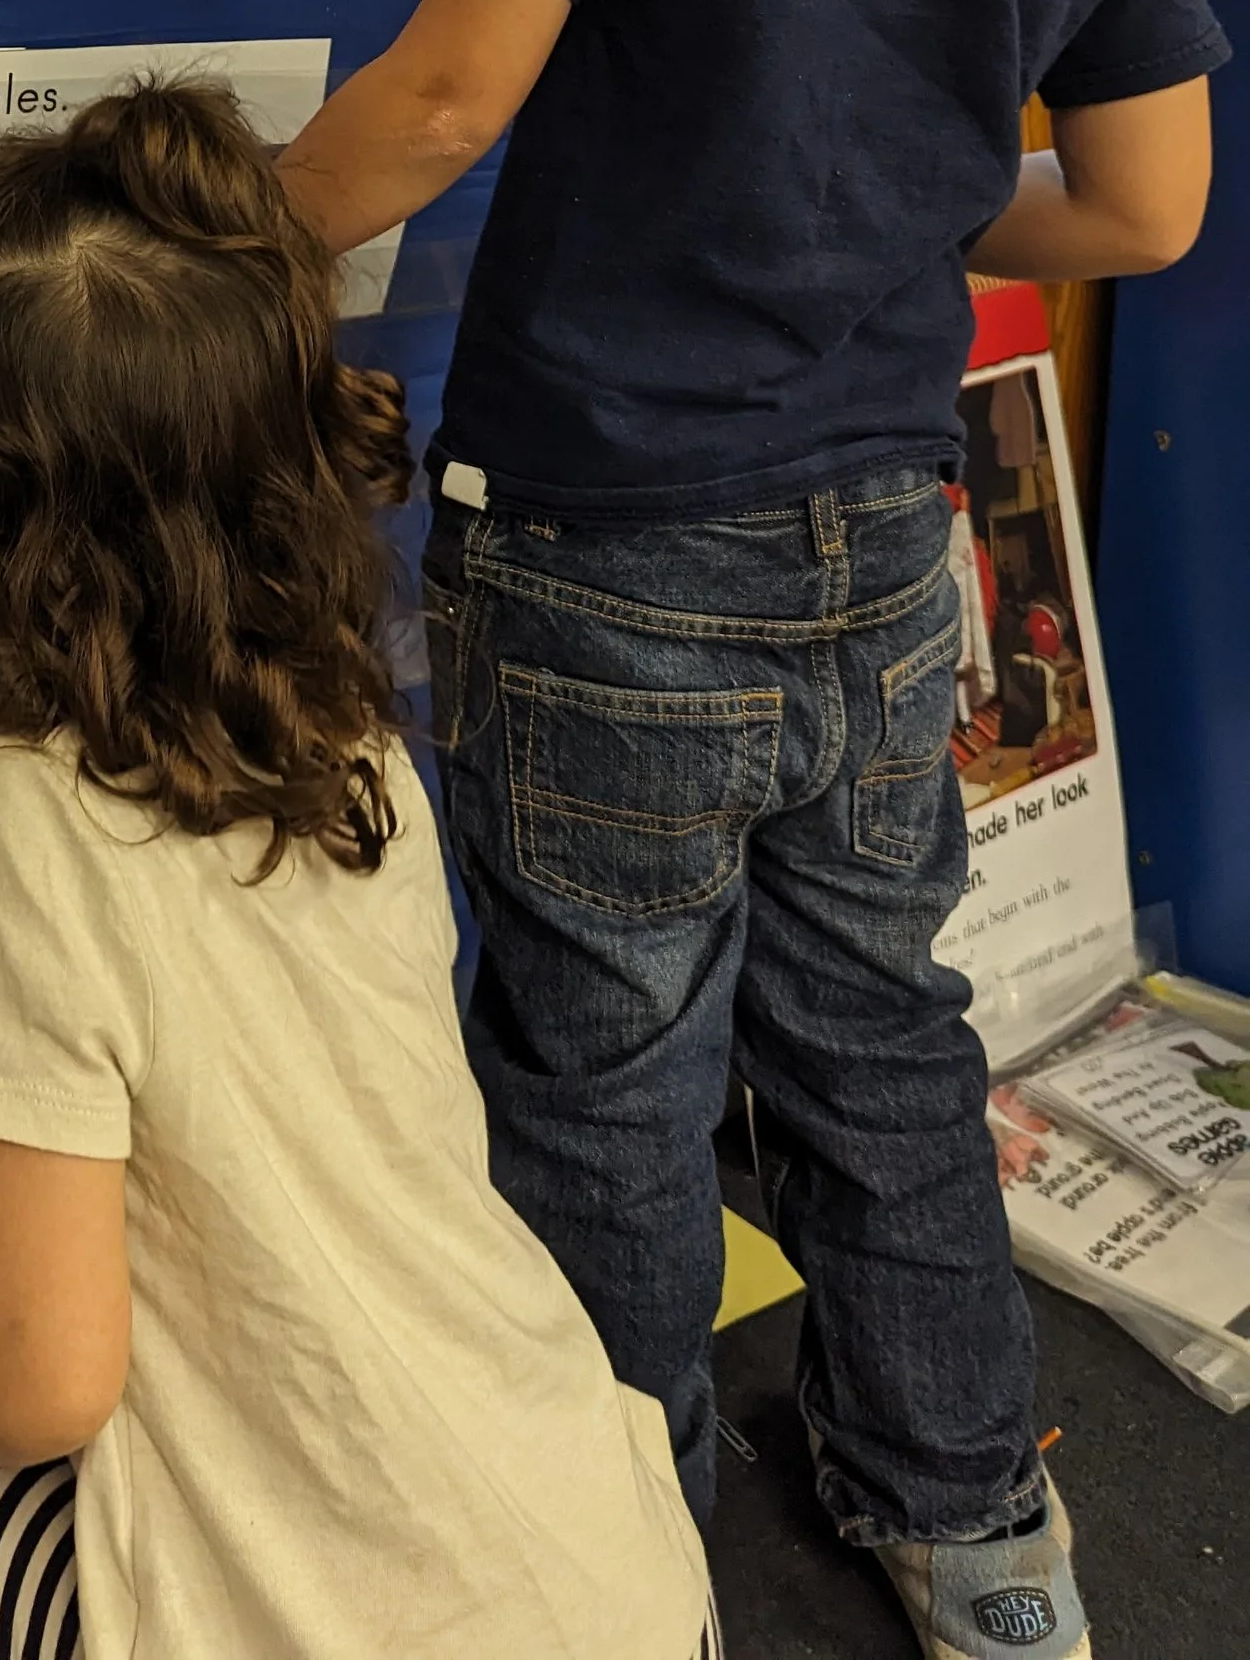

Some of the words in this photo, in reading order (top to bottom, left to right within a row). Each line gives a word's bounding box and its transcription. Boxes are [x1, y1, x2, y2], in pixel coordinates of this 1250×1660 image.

[1014, 797, 1045, 828] her
[1051, 772, 1090, 811] look
[988, 900, 1019, 925] begin
[1022, 883, 1050, 908] with
[1083, 1239, 1119, 1265] be?
[984, 1599, 1048, 1638] DUDE
[998, 1595, 1029, 1615] HEY
